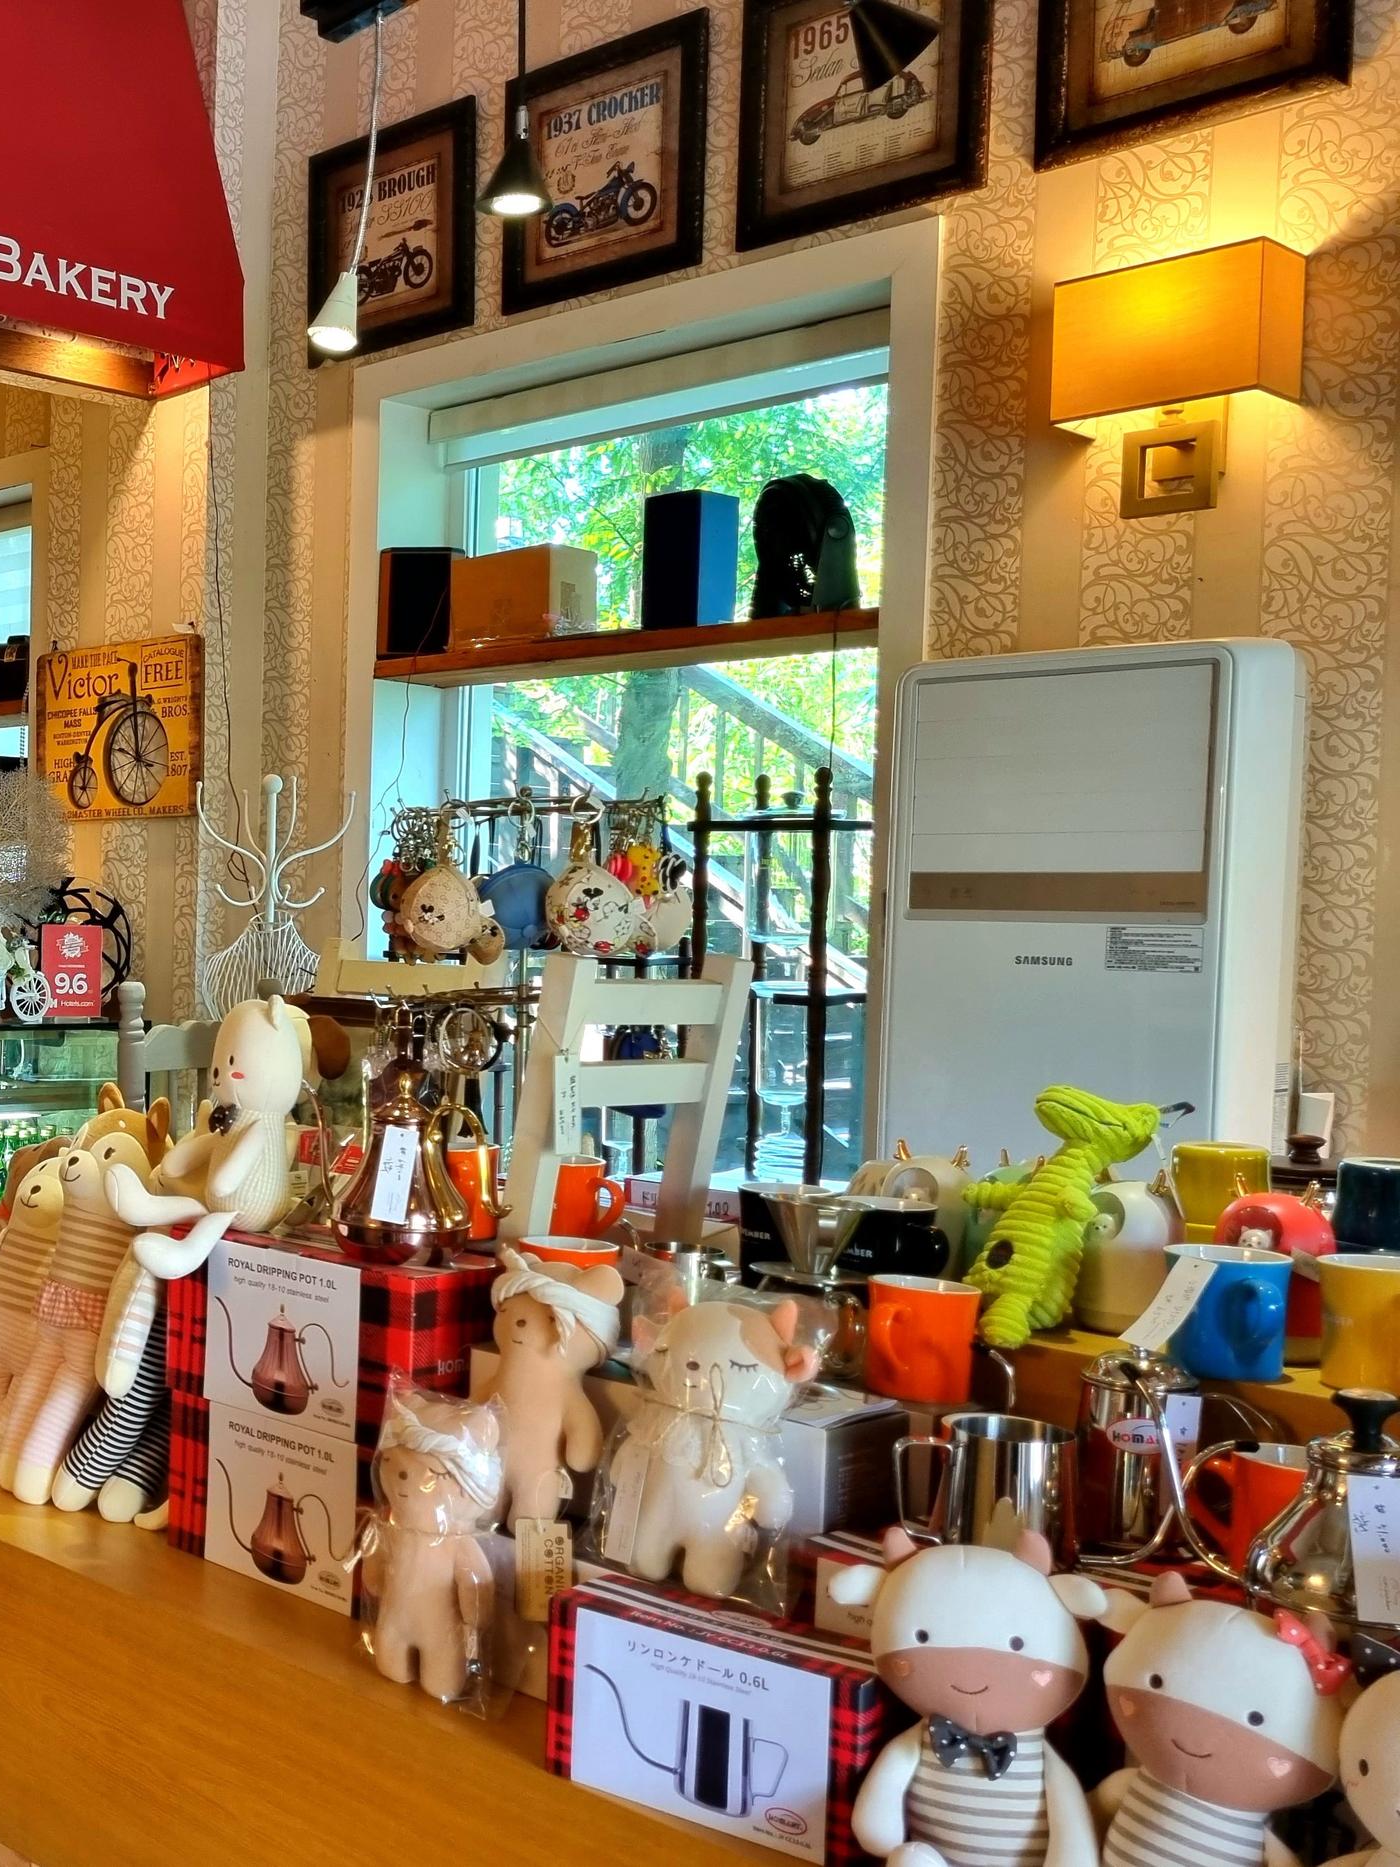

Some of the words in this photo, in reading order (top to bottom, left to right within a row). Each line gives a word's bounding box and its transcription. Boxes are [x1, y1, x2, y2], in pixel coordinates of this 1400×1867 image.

[791, 14, 849, 60] 1965
[546, 109, 582, 140] 1937
[587, 82, 660, 126] CROCKER
[378, 163, 435, 202] BROUGH
[72, 655, 88, 670] MAKE
[90, 653, 101, 667] THE
[143, 648, 184, 663] CATALOGUE
[48, 653, 119, 701] Victor
[144, 660, 183, 683] FREE
[64, 719, 81, 728] MASS
[54, 759, 75, 769] HIGH
[170, 751, 186, 762] EST.
[104, 808, 130, 816] WHEEL
[149, 805, 183, 814] MAKERS
[1015, 955, 1073, 966] SAMSUNG
[55, 973, 88, 994] 9.6
[228, 1257, 255, 1272] ROYAL
[257, 1264, 298, 1281] DRIPPING
[299, 1273, 317, 1285] POT
[319, 1278, 337, 1290] 1.0L
[229, 1421, 255, 1437] ROYAL
[256, 1430, 296, 1450] DRIPPING
[297, 1443, 315, 1456] POT
[317, 1450, 335, 1463] 1.0L
[544, 1539, 554, 1595] COTTON
[739, 1672, 770, 1691] 0.6L
